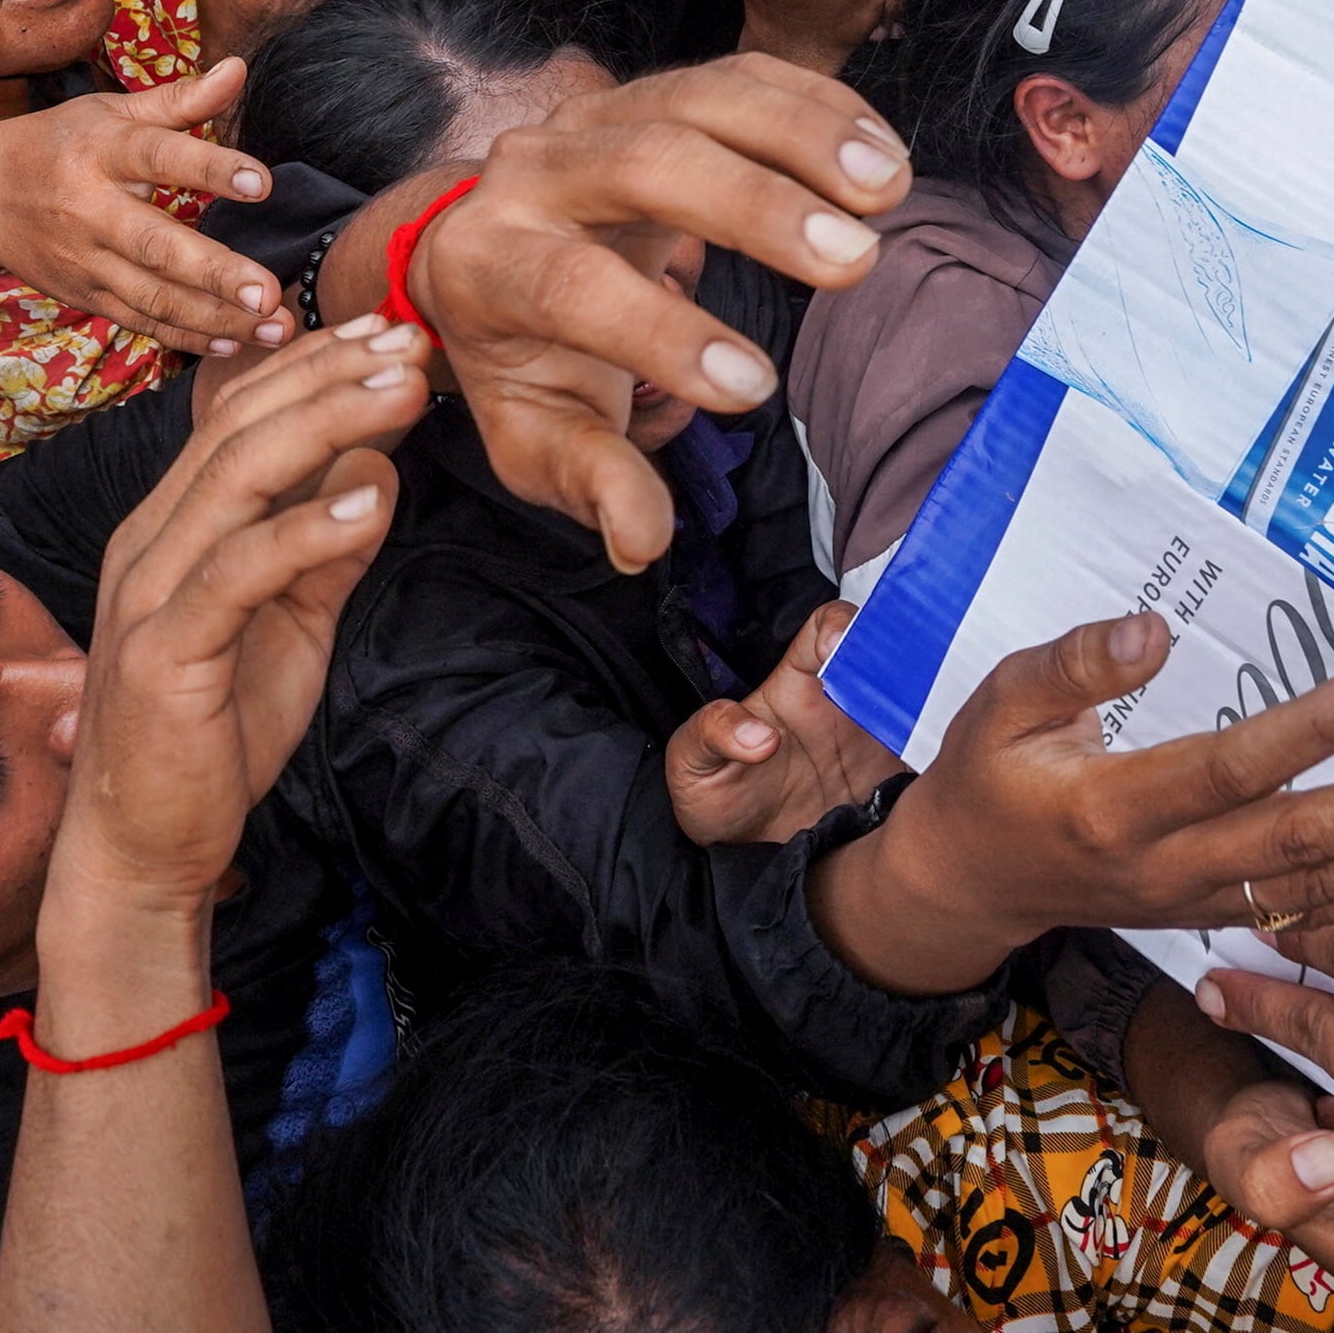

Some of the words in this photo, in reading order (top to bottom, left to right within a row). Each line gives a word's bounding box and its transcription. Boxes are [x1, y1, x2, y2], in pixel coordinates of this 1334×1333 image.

[1286, 382, 1323, 446] EUROPEAN
[1125, 534, 1192, 619] EUROP
[1173, 558, 1224, 626] WITH
